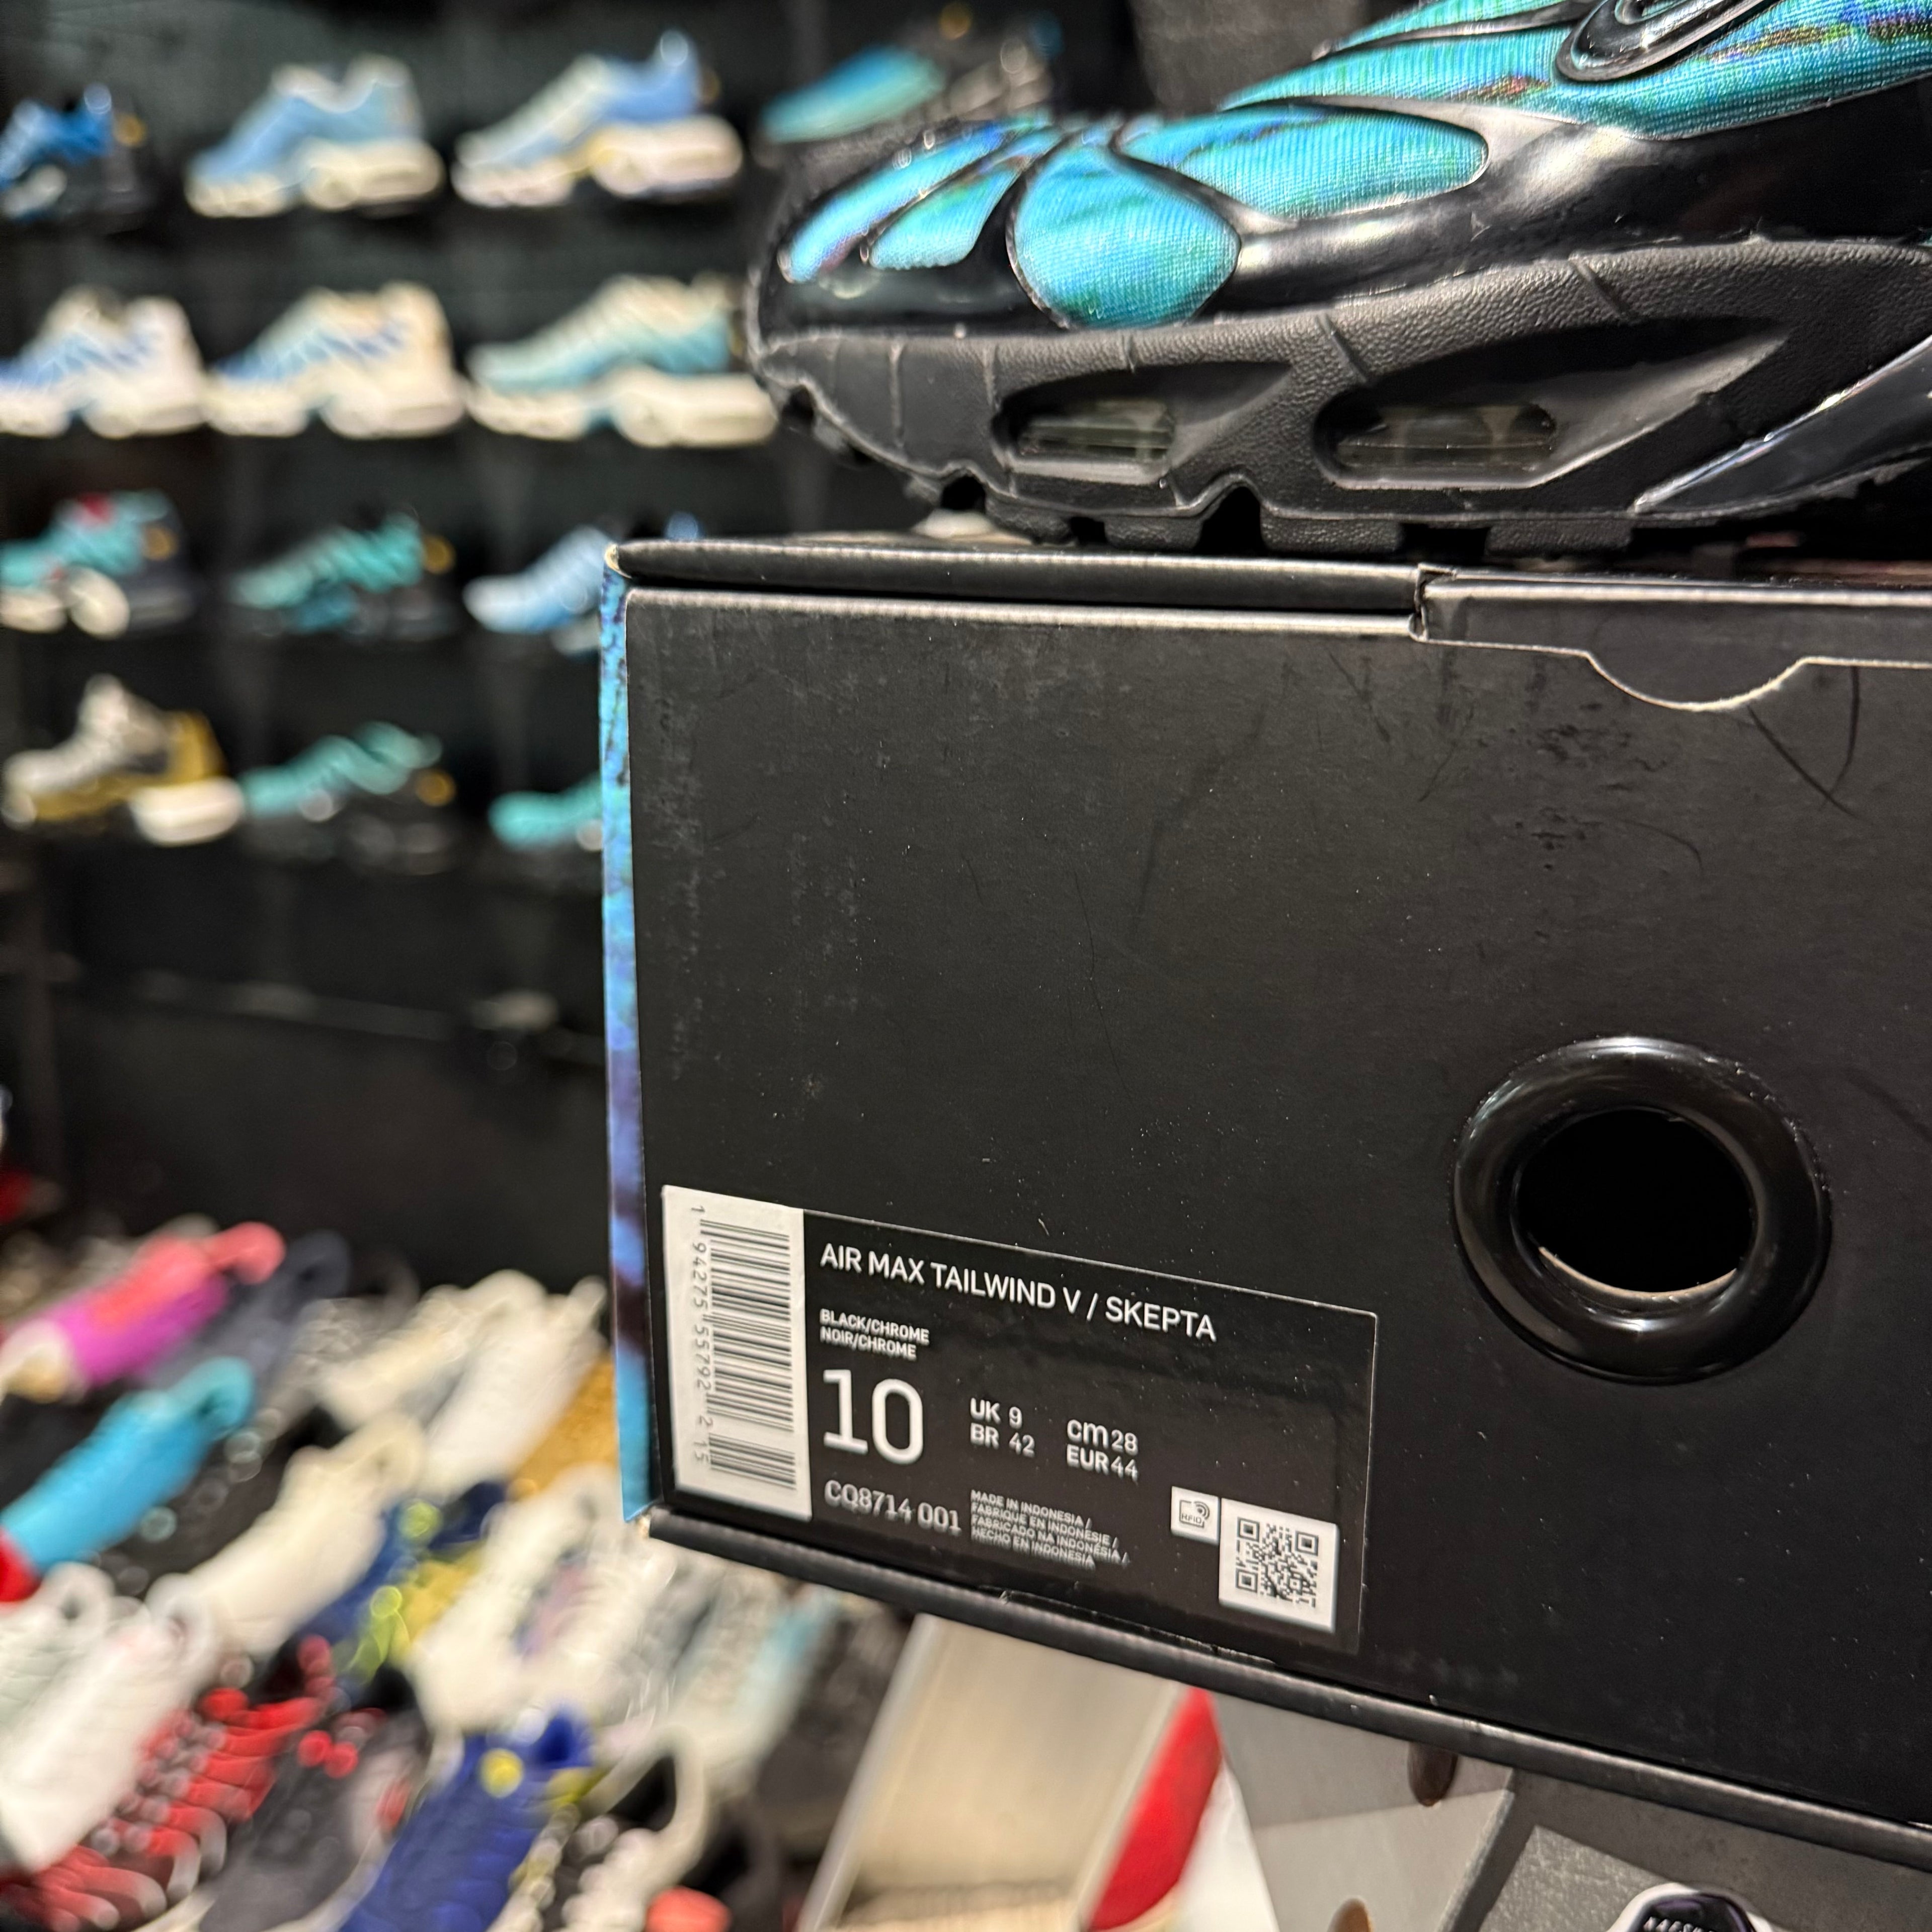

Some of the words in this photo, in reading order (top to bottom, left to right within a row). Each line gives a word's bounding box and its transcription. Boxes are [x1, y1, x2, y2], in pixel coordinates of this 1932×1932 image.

[693, 1242, 708, 1311] 94275
[820, 1243, 862, 1273] AIR
[868, 1251, 925, 1285] MAX
[930, 1261, 1056, 1309] TAILWIND
[1063, 1286, 1082, 1315] V
[1086, 1293, 1098, 1322] /
[1105, 1296, 1217, 1343] SKEPTA
[820, 1308, 930, 1346] BLACK/CHROME
[820, 1326, 917, 1361] NOIR/CHROME
[694, 1324, 711, 1391] 55792
[699, 1415, 713, 1428] 2
[823, 1369, 924, 1465] 10
[970, 1397, 1001, 1425] UK
[1008, 1406, 1023, 1429] 9
[970, 1422, 1000, 1450] BR
[1008, 1432, 1035, 1458] 42
[1111, 1429, 1139, 1456] 28
[1066, 1443, 1110, 1475] EUR
[1110, 1456, 1139, 1482] 44
[824, 1480, 912, 1524] CQ8714
[917, 1502, 962, 1537] 001
[971, 1489, 1005, 1506] MADE
[1006, 1497, 1019, 1511] IN
[1020, 1501, 1085, 1527] INDONESIA
[971, 1502, 1028, 1525] FABRIQUE
[1029, 1515, 1046, 1530] EN
[1181, 1513, 1202, 1524] RFID
[971, 1514, 1036, 1540] FABRICADO
[1037, 1530, 1056, 1545] NA
[971, 1525, 1012, 1550] HECHO
[1012, 1535, 1030, 1554] EN
[1031, 1541, 1096, 1570] INDONESIA
